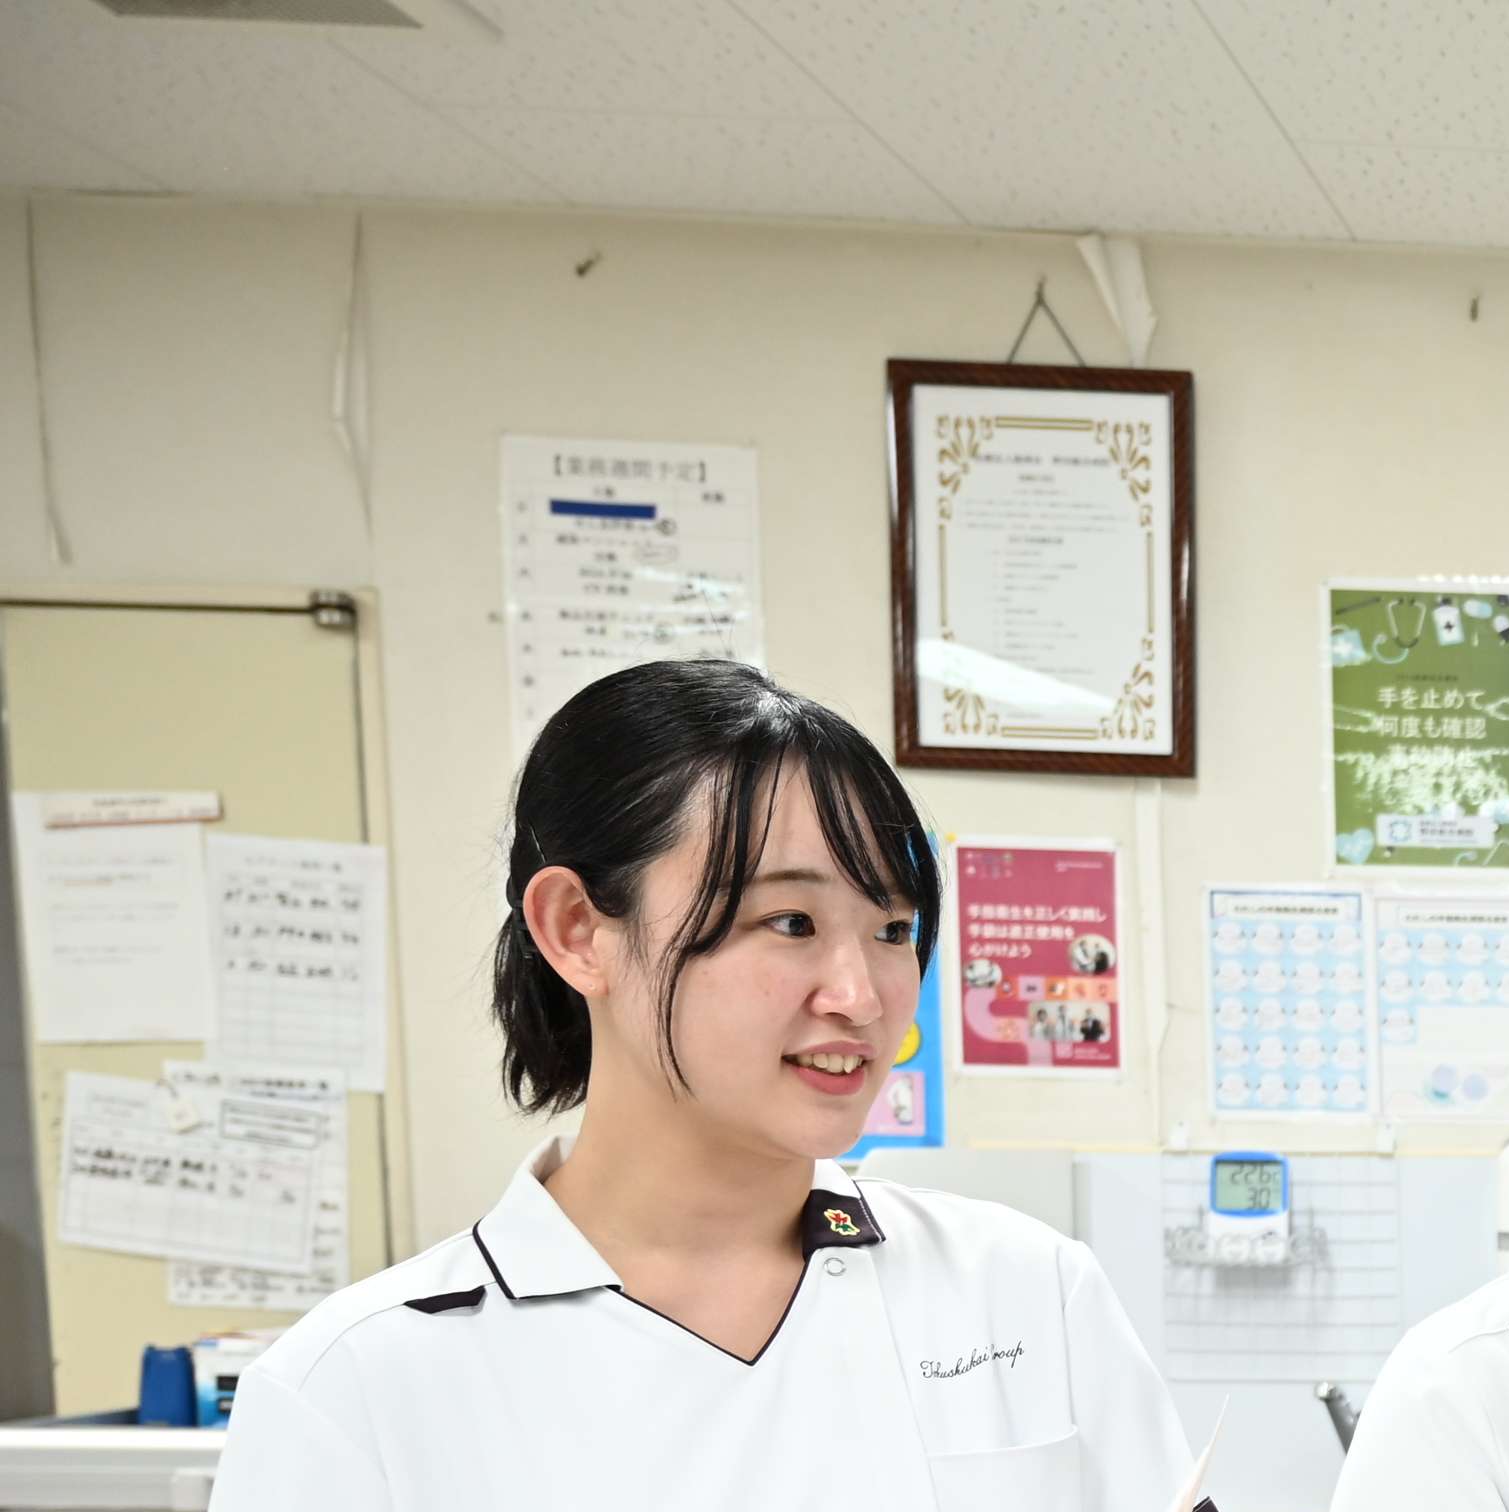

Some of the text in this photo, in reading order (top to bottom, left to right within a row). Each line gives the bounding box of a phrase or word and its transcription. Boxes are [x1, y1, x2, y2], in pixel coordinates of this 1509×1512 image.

[1377, 686, 1486, 710] 手を止めて
[1378, 715, 1487, 740] 何度も確認
